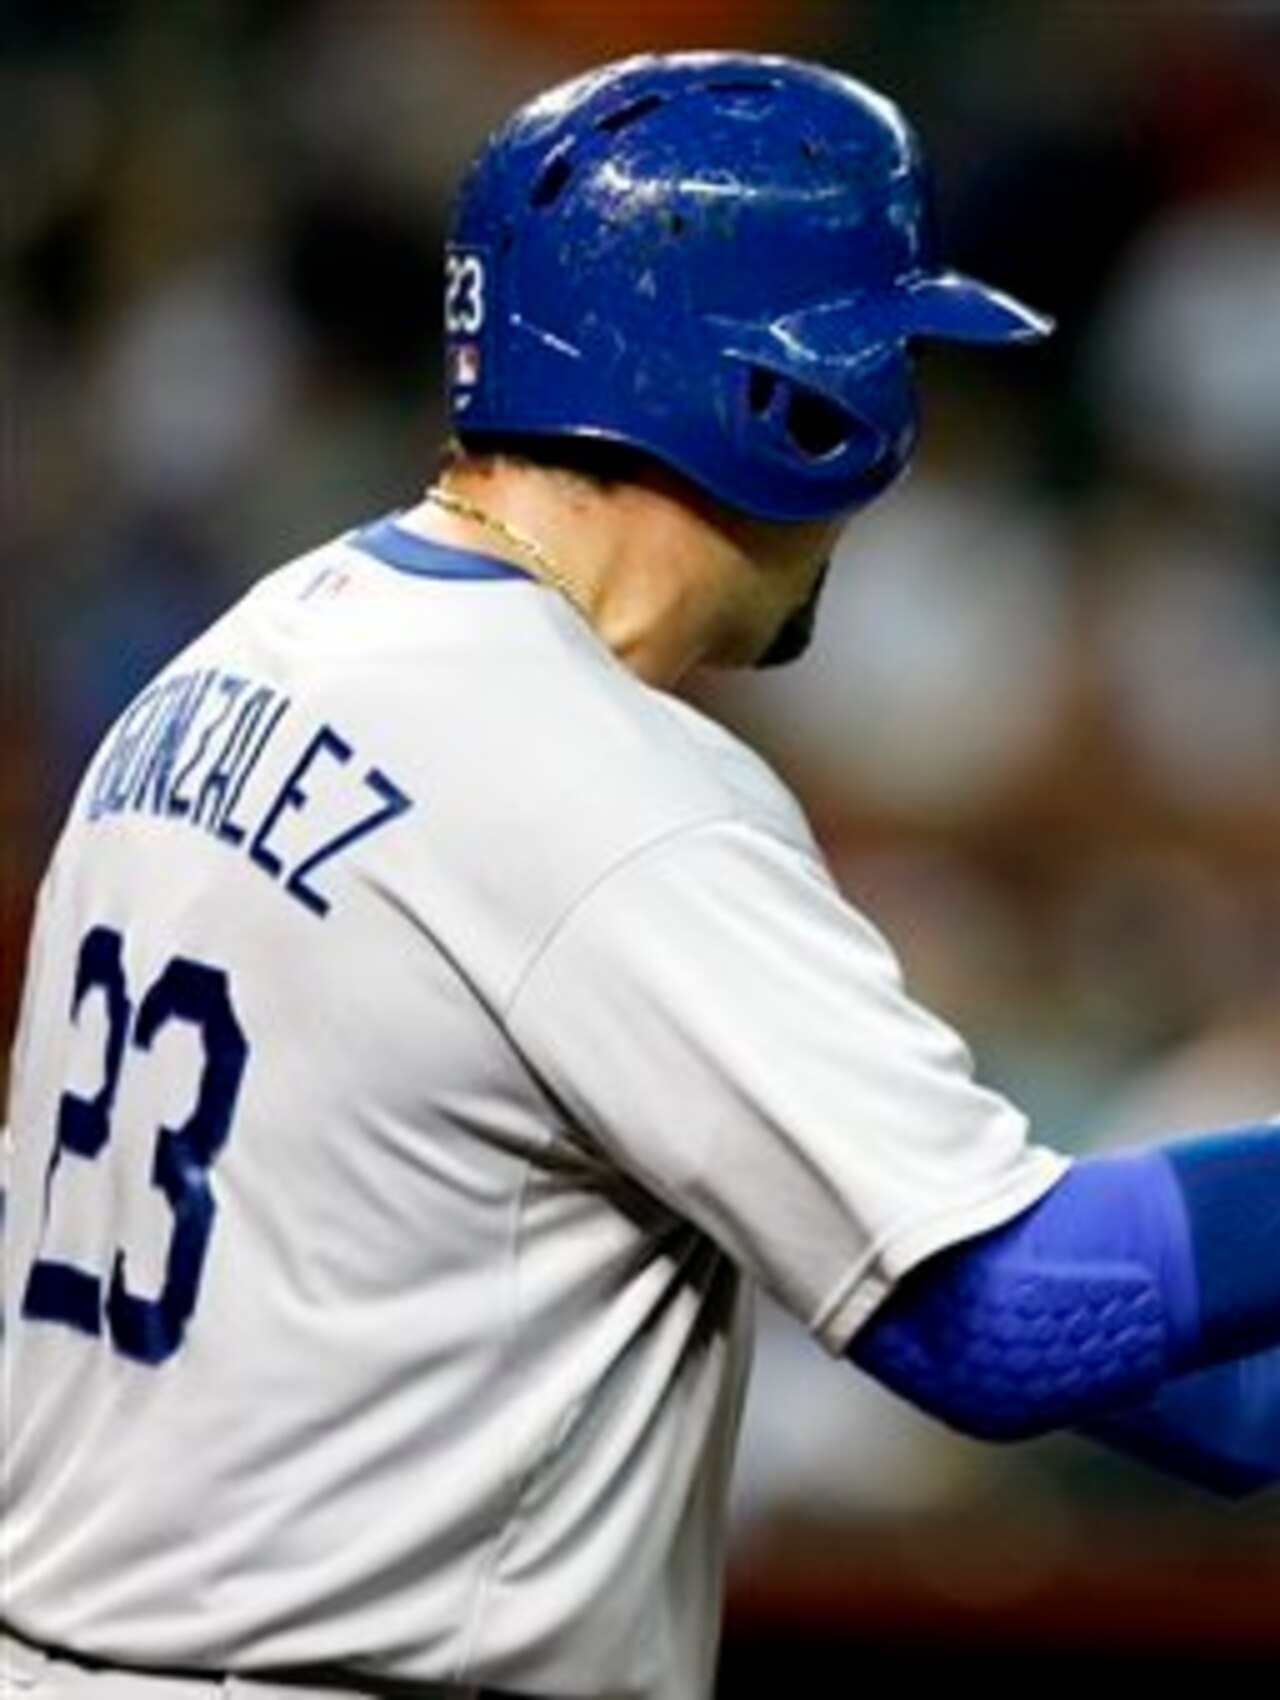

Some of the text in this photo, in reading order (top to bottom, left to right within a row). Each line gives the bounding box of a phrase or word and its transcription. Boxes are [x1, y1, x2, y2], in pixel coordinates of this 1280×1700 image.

[445, 256, 484, 332] 23
[88, 669, 413, 919] GONZALEZ
[22, 924, 249, 1366] 23
